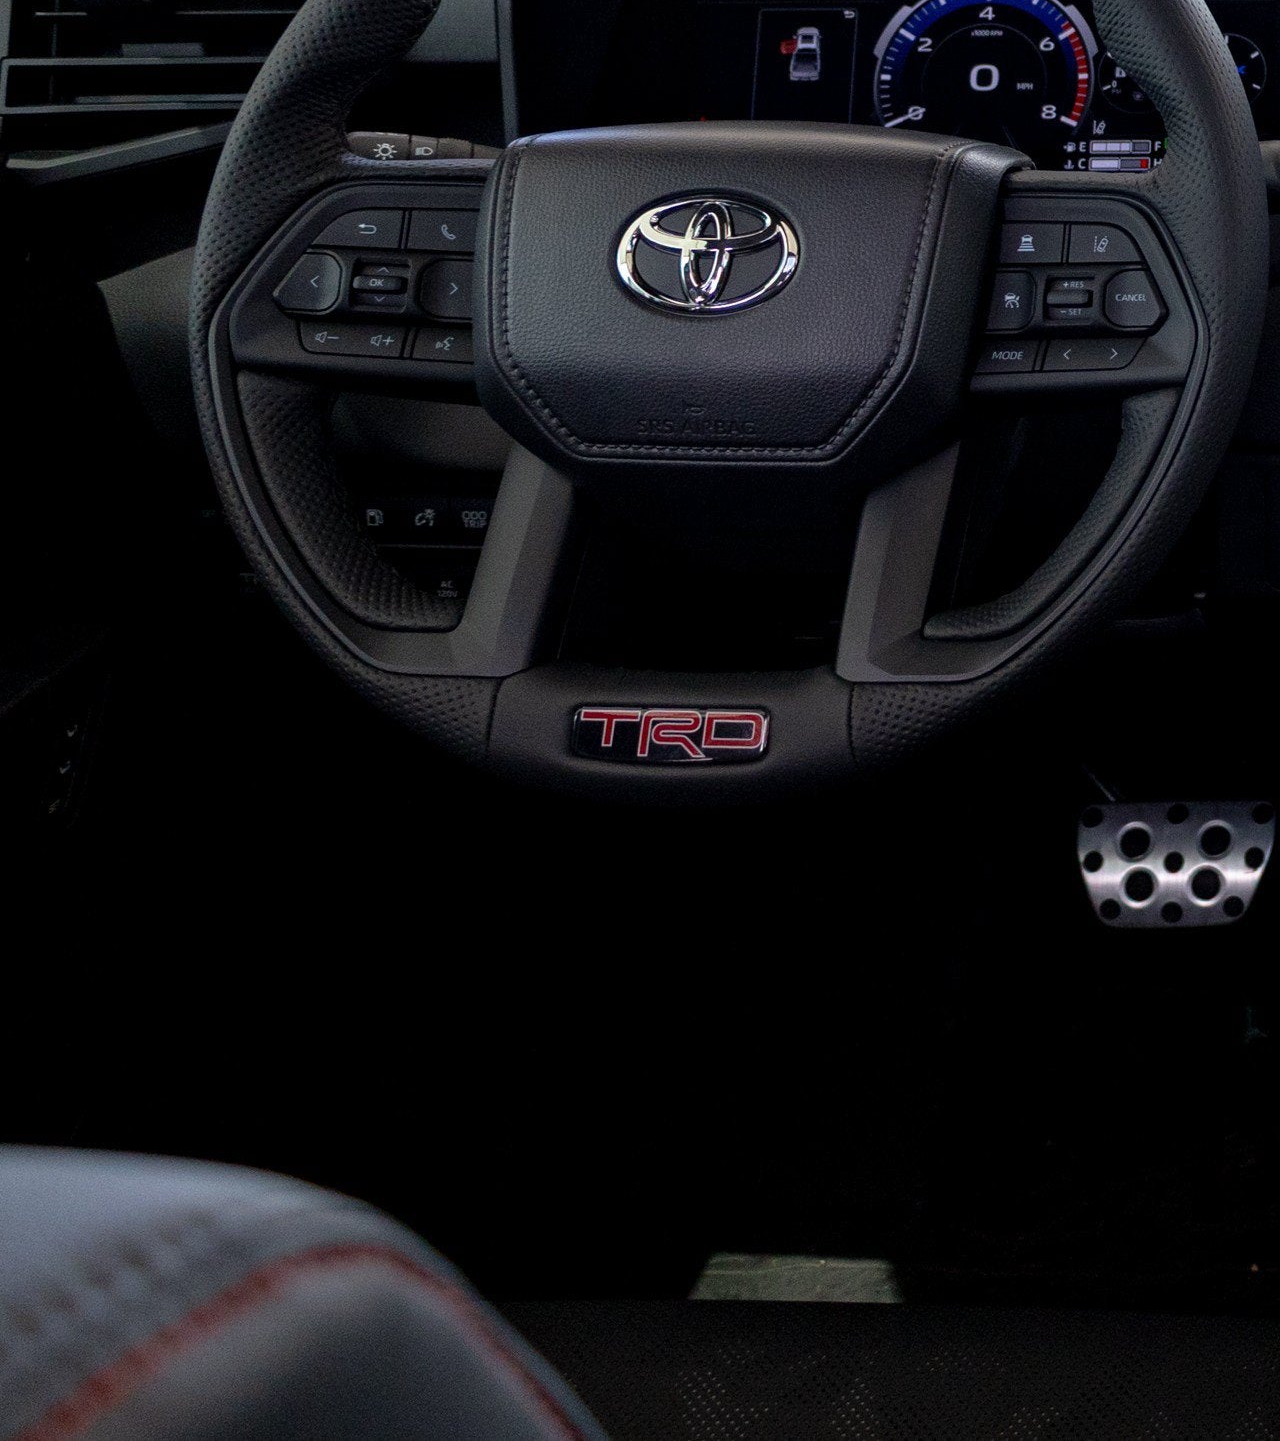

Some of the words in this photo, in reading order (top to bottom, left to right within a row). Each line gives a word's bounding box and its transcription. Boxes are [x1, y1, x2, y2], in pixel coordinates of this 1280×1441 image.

[979, 6, 996, 20] 4
[916, 38, 934, 53] 2
[1039, 37, 1056, 52] 6
[968, 63, 1000, 92] 0
[1016, 82, 1034, 91] MPH
[1040, 104, 1057, 120] 8
[1079, 141, 1087, 152] E
[1154, 141, 1162, 152] F
[1077, 158, 1087, 170] C
[368, 278, 384, 287] OK
[1070, 280, 1084, 289] RES
[1115, 293, 1148, 302] CANCEL
[1069, 308, 1083, 317] SET
[992, 350, 1024, 360] MODE
[463, 519, 488, 529] TRIP
[579, 708, 767, 759] TRD
